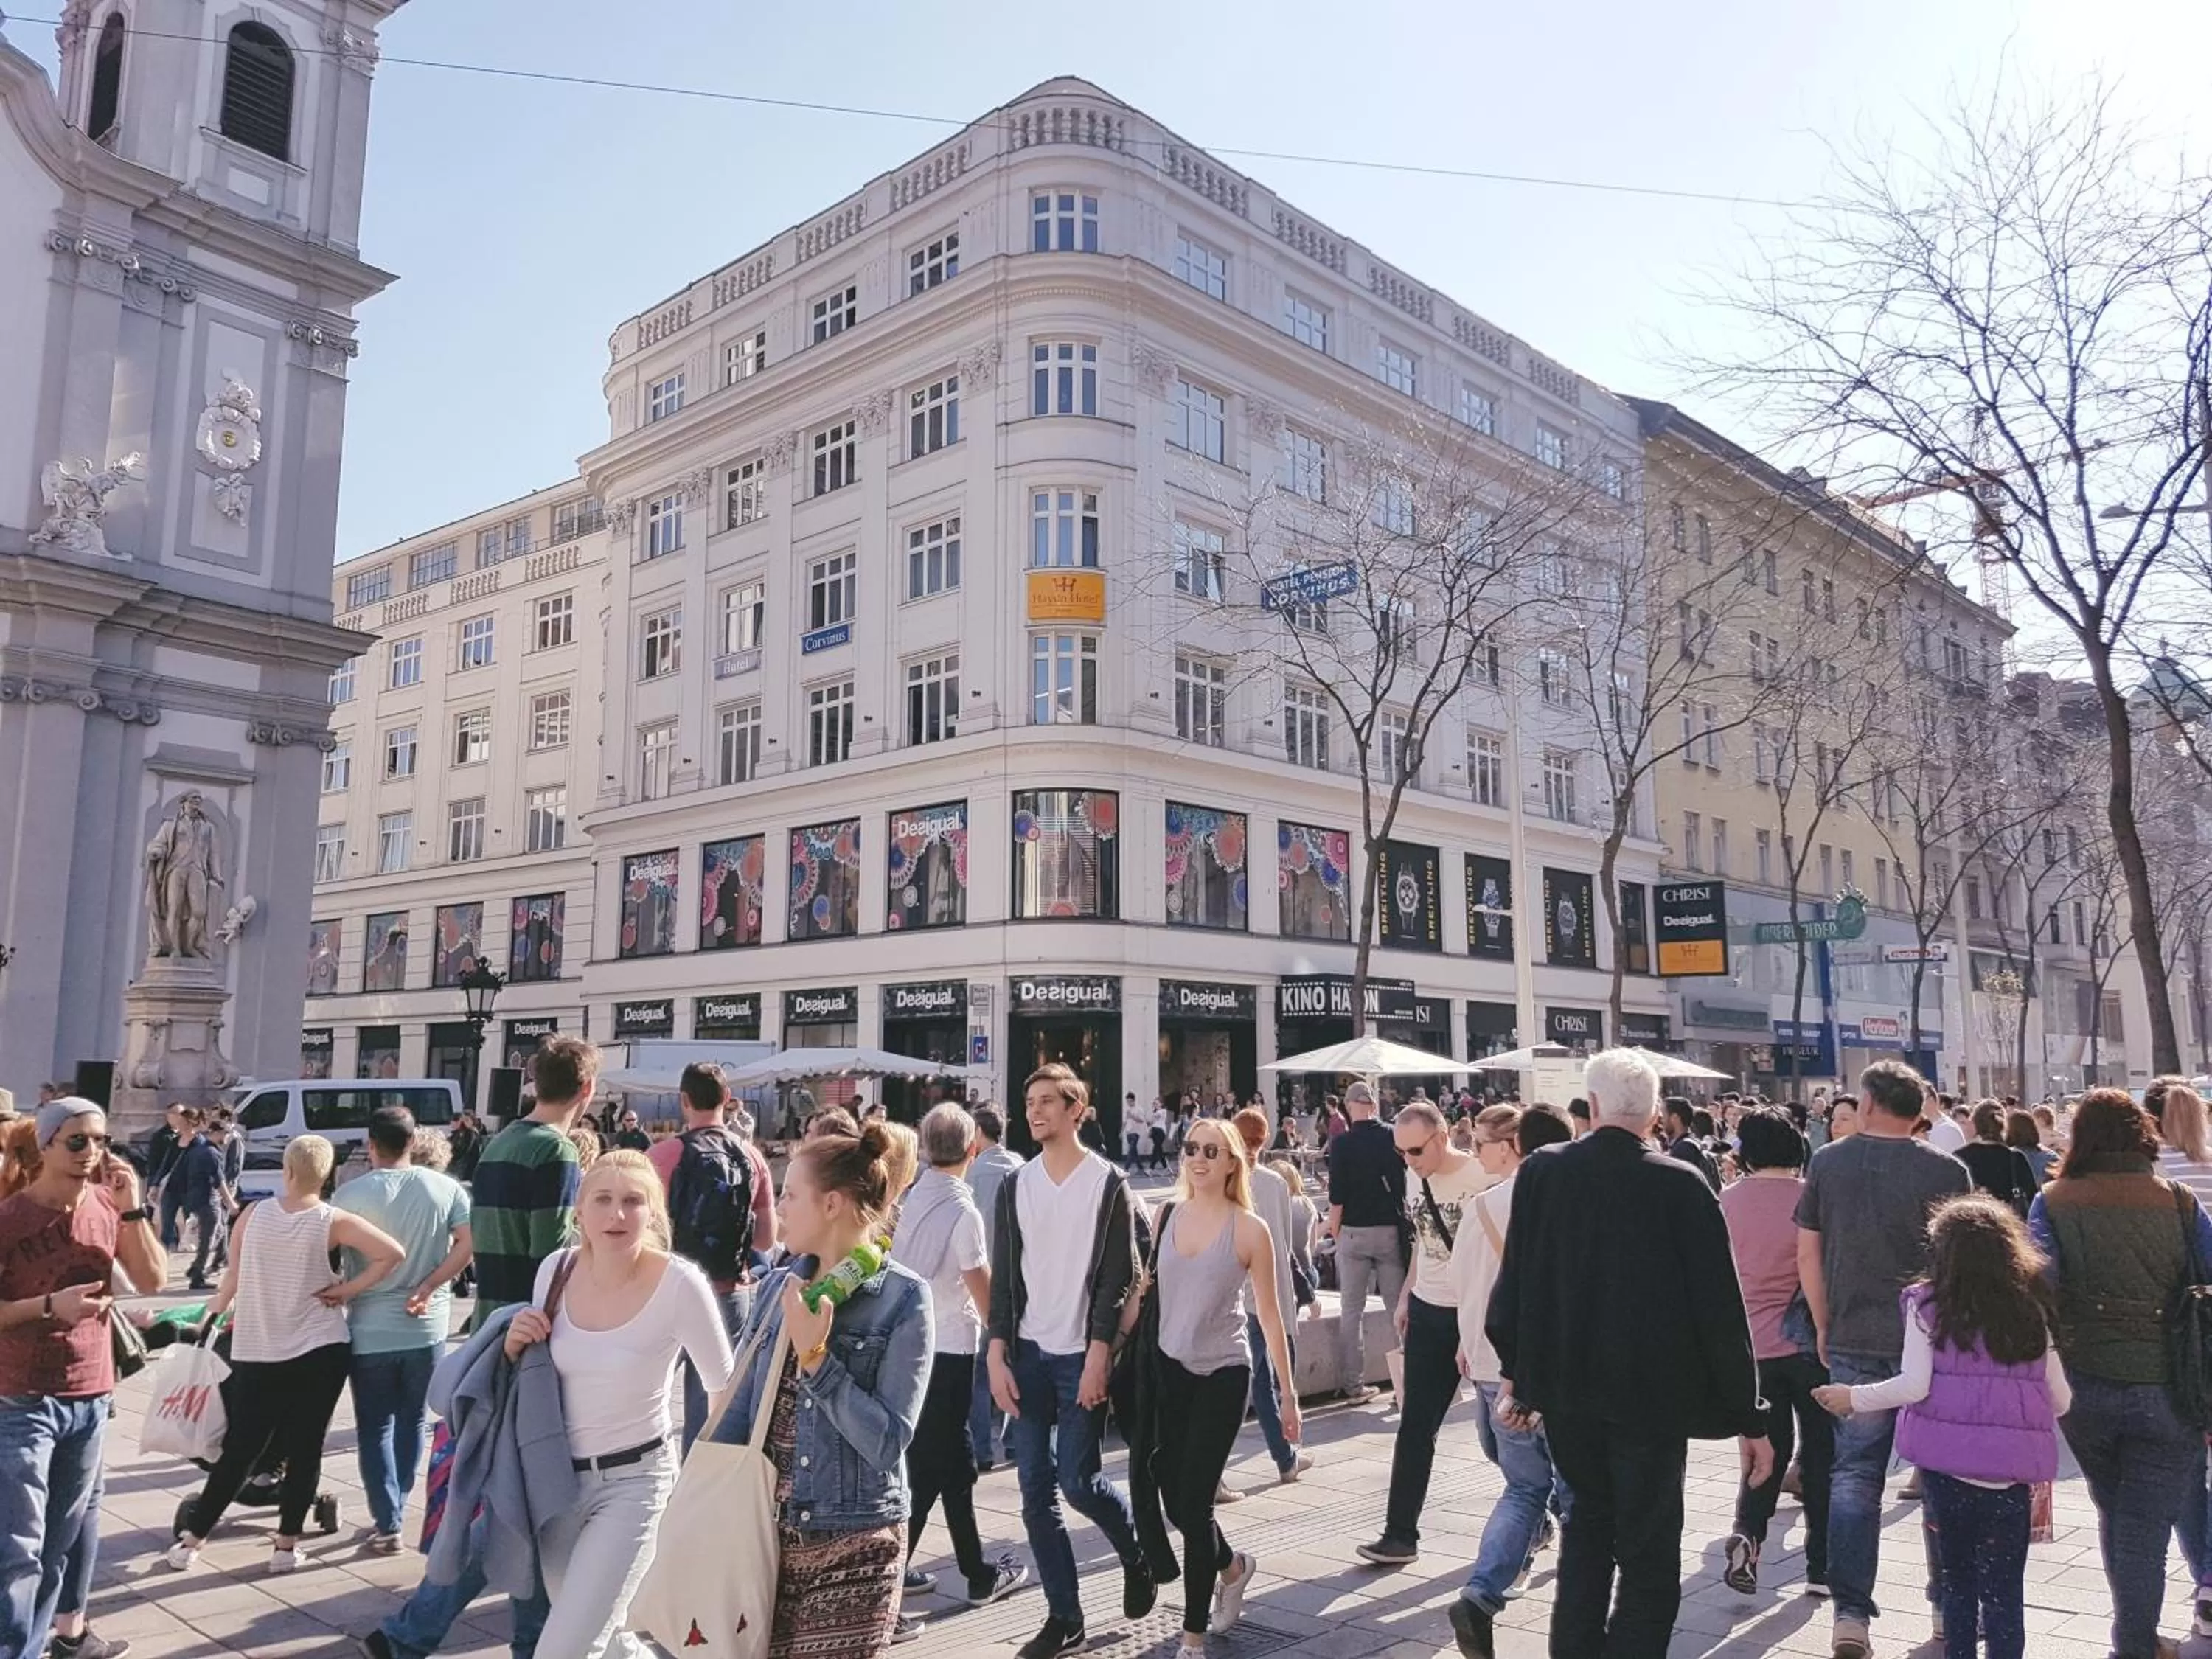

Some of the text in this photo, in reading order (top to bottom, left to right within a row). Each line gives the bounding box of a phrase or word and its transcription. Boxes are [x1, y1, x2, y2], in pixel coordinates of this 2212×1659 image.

[804, 630, 846, 652] Corvinus
[723, 656, 749, 675] Hotel
[1380, 852, 1388, 934] BREITLING
[1426, 860, 1436, 940] BREITLING
[1663, 887, 1711, 902] CHRIST
[1281, 987, 1380, 1014] KINO HAN
[1555, 1014, 1589, 1032] CHRIST
[156, 1383, 211, 1423] H&M
